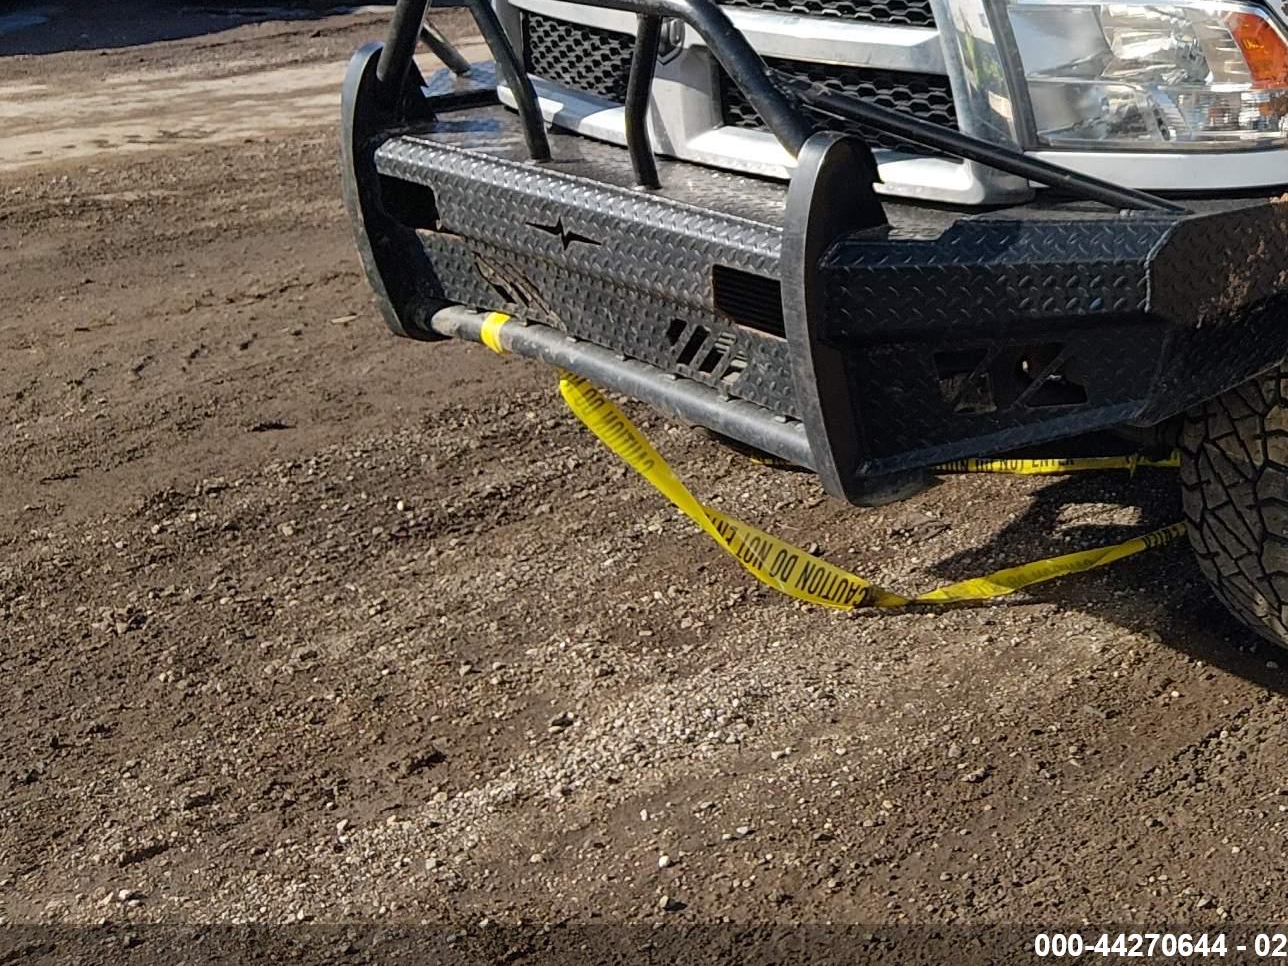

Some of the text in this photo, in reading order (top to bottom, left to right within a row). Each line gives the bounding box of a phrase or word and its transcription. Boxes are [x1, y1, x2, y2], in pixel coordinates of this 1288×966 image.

[735, 532, 774, 572] NOT
[769, 548, 799, 583] DO
[795, 559, 870, 607] CAUTION
